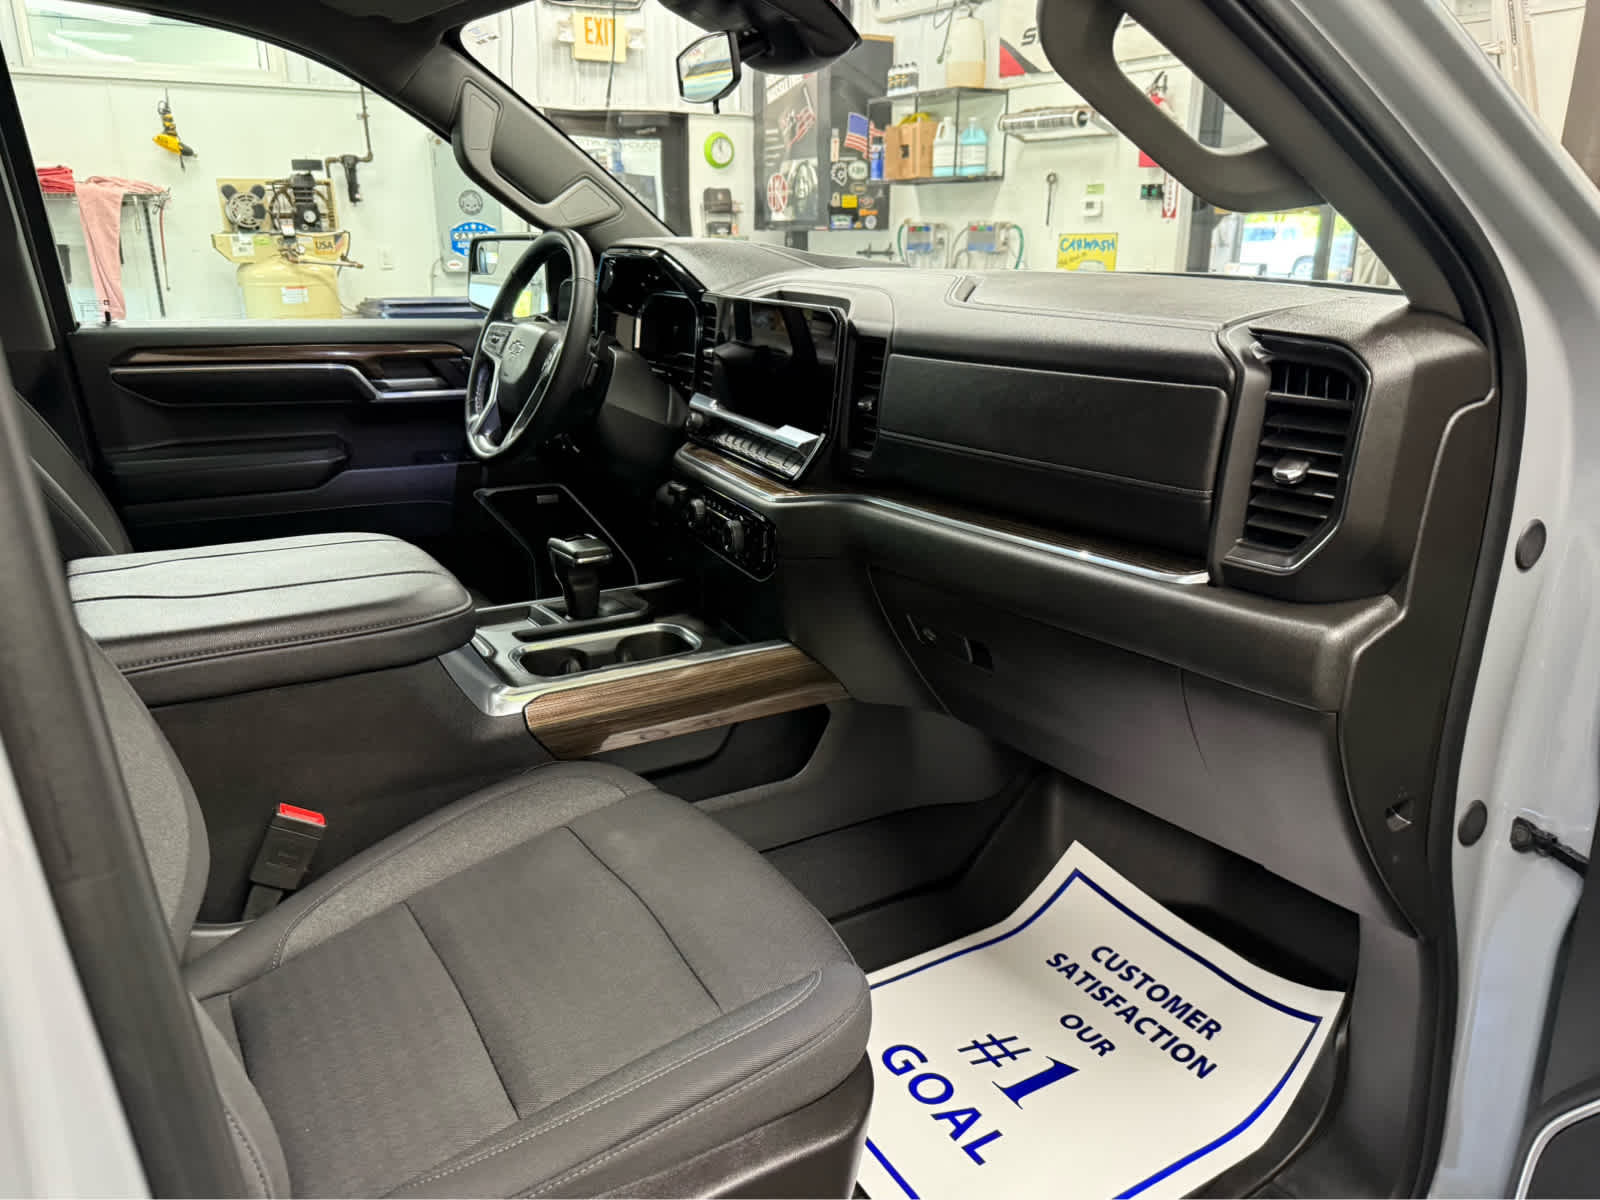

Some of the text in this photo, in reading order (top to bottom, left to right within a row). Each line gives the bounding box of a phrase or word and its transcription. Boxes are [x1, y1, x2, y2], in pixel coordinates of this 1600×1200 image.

[583, 16, 616, 47] EXIT
[314, 239, 334, 251] USA
[1059, 237, 1116, 253] CARWASH
[1045, 951, 1217, 1079] SATISFACTION
[1091, 945, 1222, 1041] CUSTOMER
[1059, 1014, 1116, 1057] OUR
[959, 1033, 1079, 1110] #1
[881, 1043, 1003, 1166] GOAL
